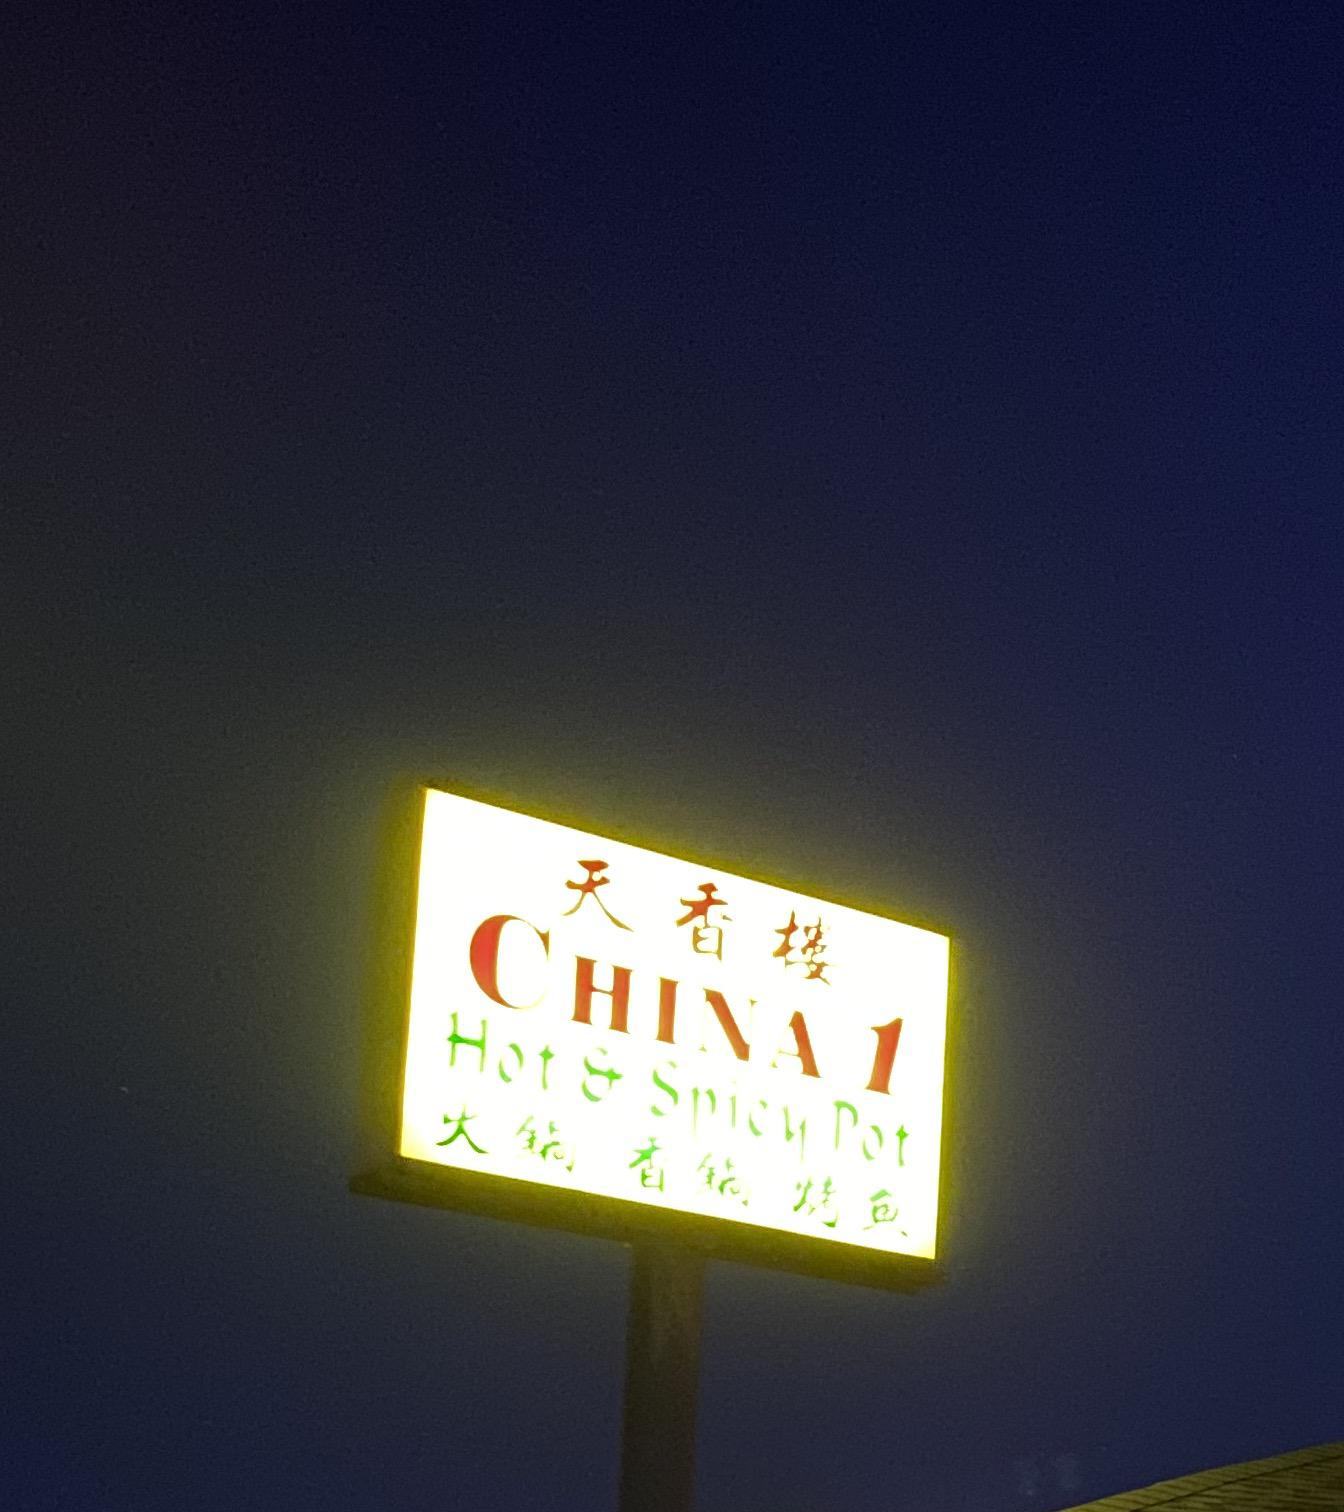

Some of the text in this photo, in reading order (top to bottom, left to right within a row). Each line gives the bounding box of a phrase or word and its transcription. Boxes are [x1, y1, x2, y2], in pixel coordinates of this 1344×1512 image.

[445, 1010, 911, 1169] Hot & Spicy Pot
[864, 1016, 905, 1096] 1
